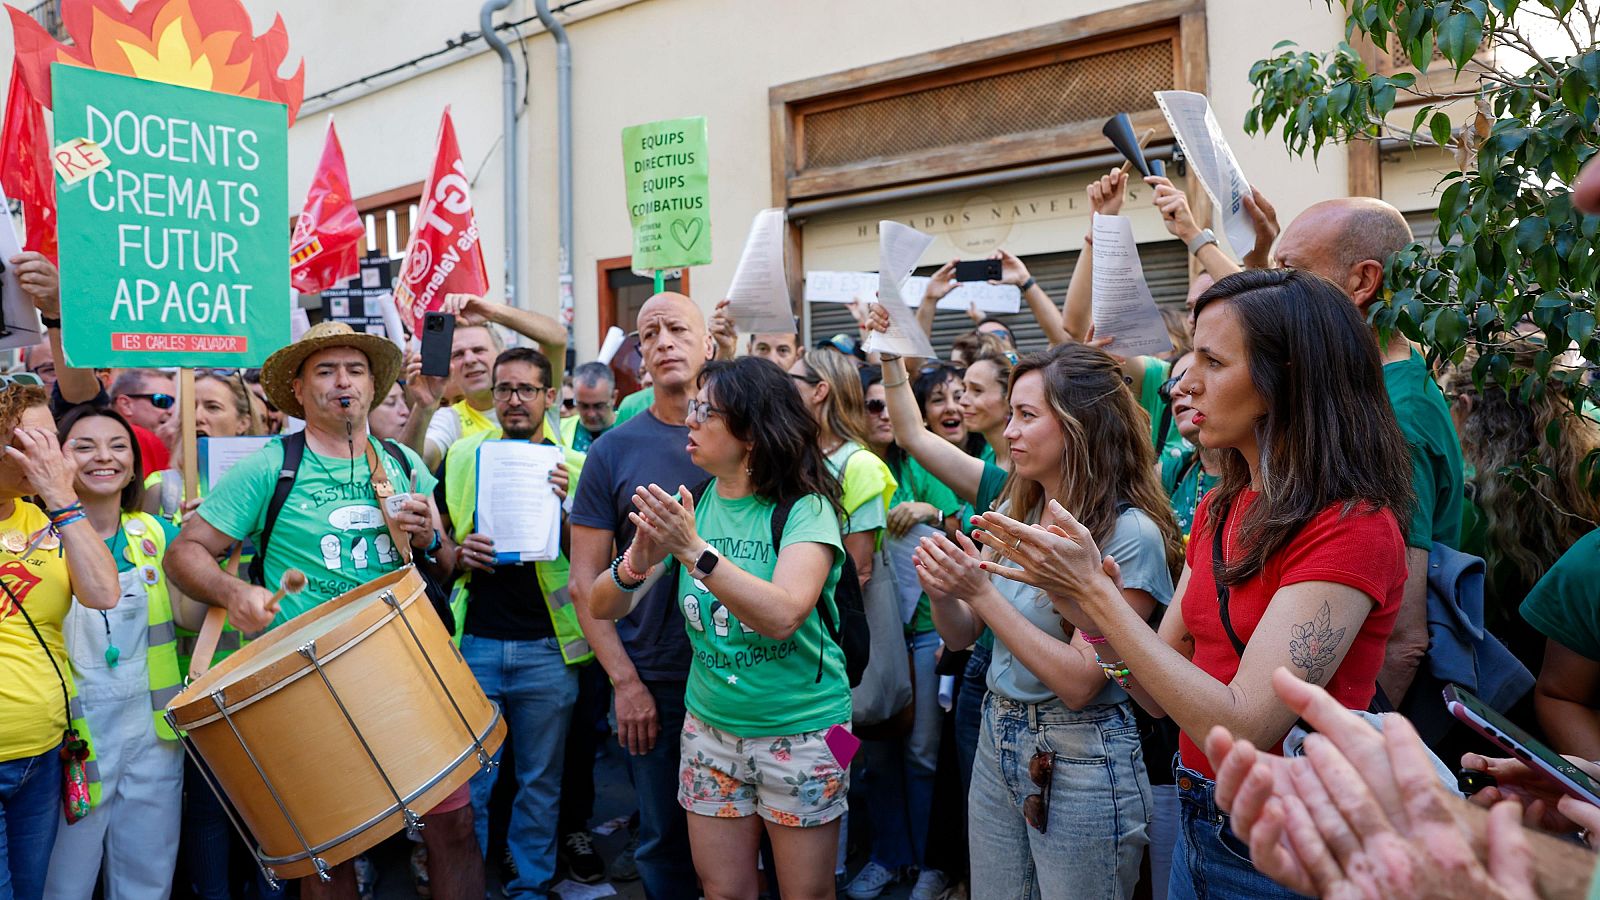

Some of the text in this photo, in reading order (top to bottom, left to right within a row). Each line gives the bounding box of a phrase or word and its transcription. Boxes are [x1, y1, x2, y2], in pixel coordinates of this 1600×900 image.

[86, 104, 260, 171] DOCENTS
[641, 131, 685, 150] EQUIPS
[55, 142, 103, 178] RE
[634, 152, 695, 173] DIRECTIUS
[88, 168, 260, 227] CREMATS
[643, 175, 685, 194] EQUIPS
[632, 196, 703, 217] COMBATIUS
[858, 190, 1141, 237] HADOS NAVELS
[118, 224, 240, 274] FUTUR
[110, 278, 253, 325] APAGAT
[121, 335, 237, 351] IES CARLES SALVADOR
[310, 482, 382, 508] ESTIM
[705, 537, 771, 564] TIMEM
[307, 577, 356, 597] L'ESCO
